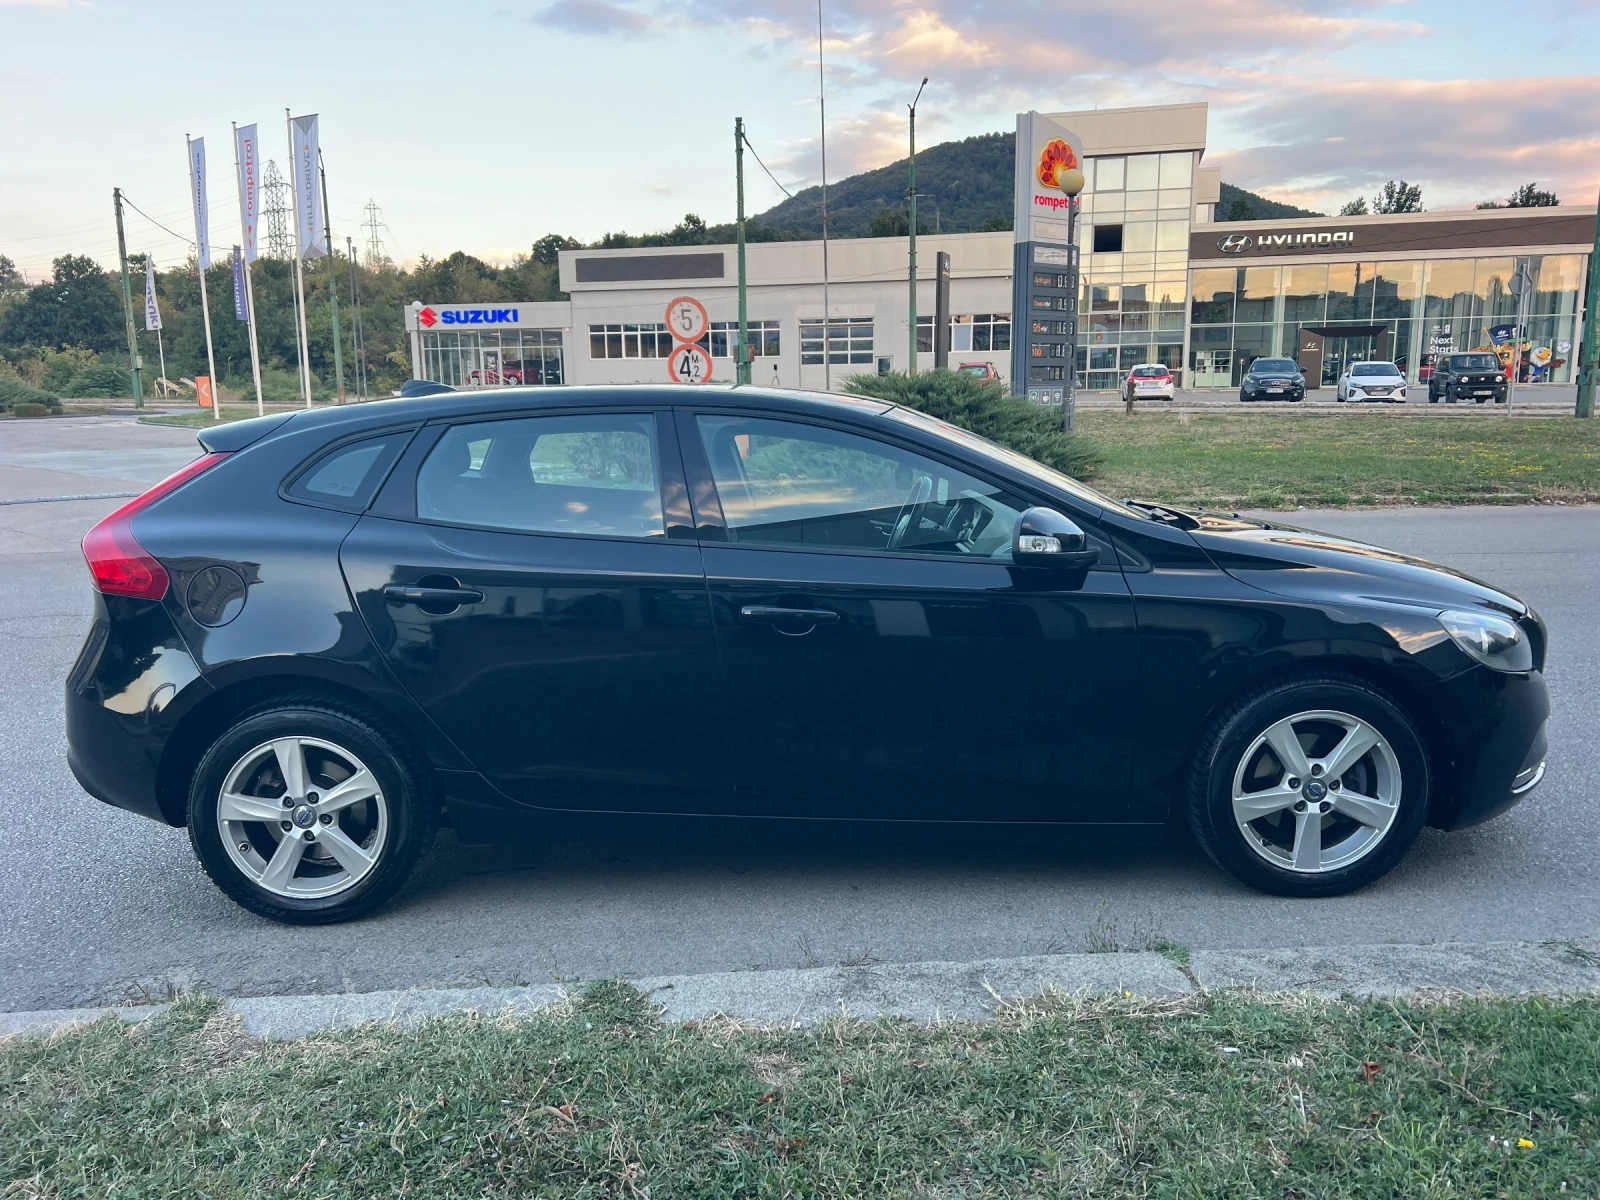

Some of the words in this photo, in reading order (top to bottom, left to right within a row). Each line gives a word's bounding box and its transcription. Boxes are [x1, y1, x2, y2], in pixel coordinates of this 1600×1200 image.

[244, 138, 254, 217] rompetrol
[304, 150, 313, 226] FILL&DRIVE
[1258, 232, 1354, 250] HYUNDAI
[441, 309, 519, 324] SUZUKI
[681, 309, 692, 331] 5
[1430, 336, 1454, 345] Next
[1032, 348, 1042, 357] 100
[1429, 346, 1459, 354] Starts
